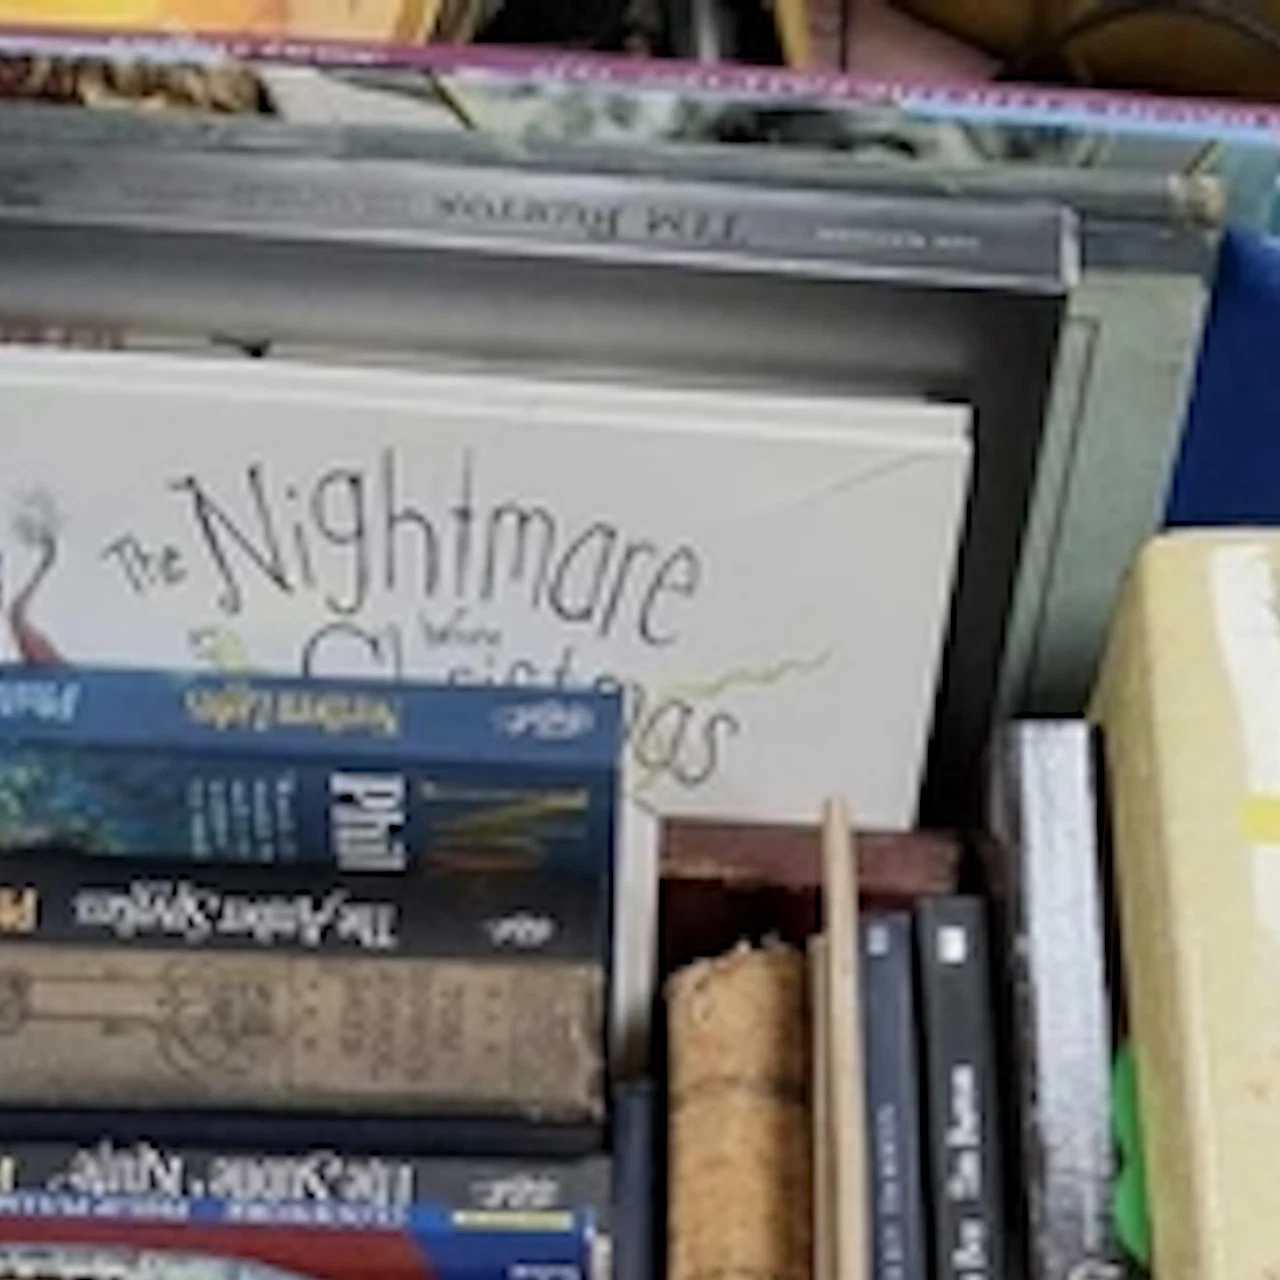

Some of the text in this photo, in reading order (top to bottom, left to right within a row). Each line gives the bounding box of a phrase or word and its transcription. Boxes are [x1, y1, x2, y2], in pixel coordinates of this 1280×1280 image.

[435, 186, 741, 245] TIM BURTON
[98, 447, 698, 645] The Nightmare
[74, 878, 395, 943] The Amber Spyglass
[940, 1064, 980, 1199] Tim Burton
[64, 1138, 187, 1197] Knife
[210, 1150, 338, 1203] Subtle
[343, 1161, 413, 1206] The
[948, 1215, 989, 1268] Boy
